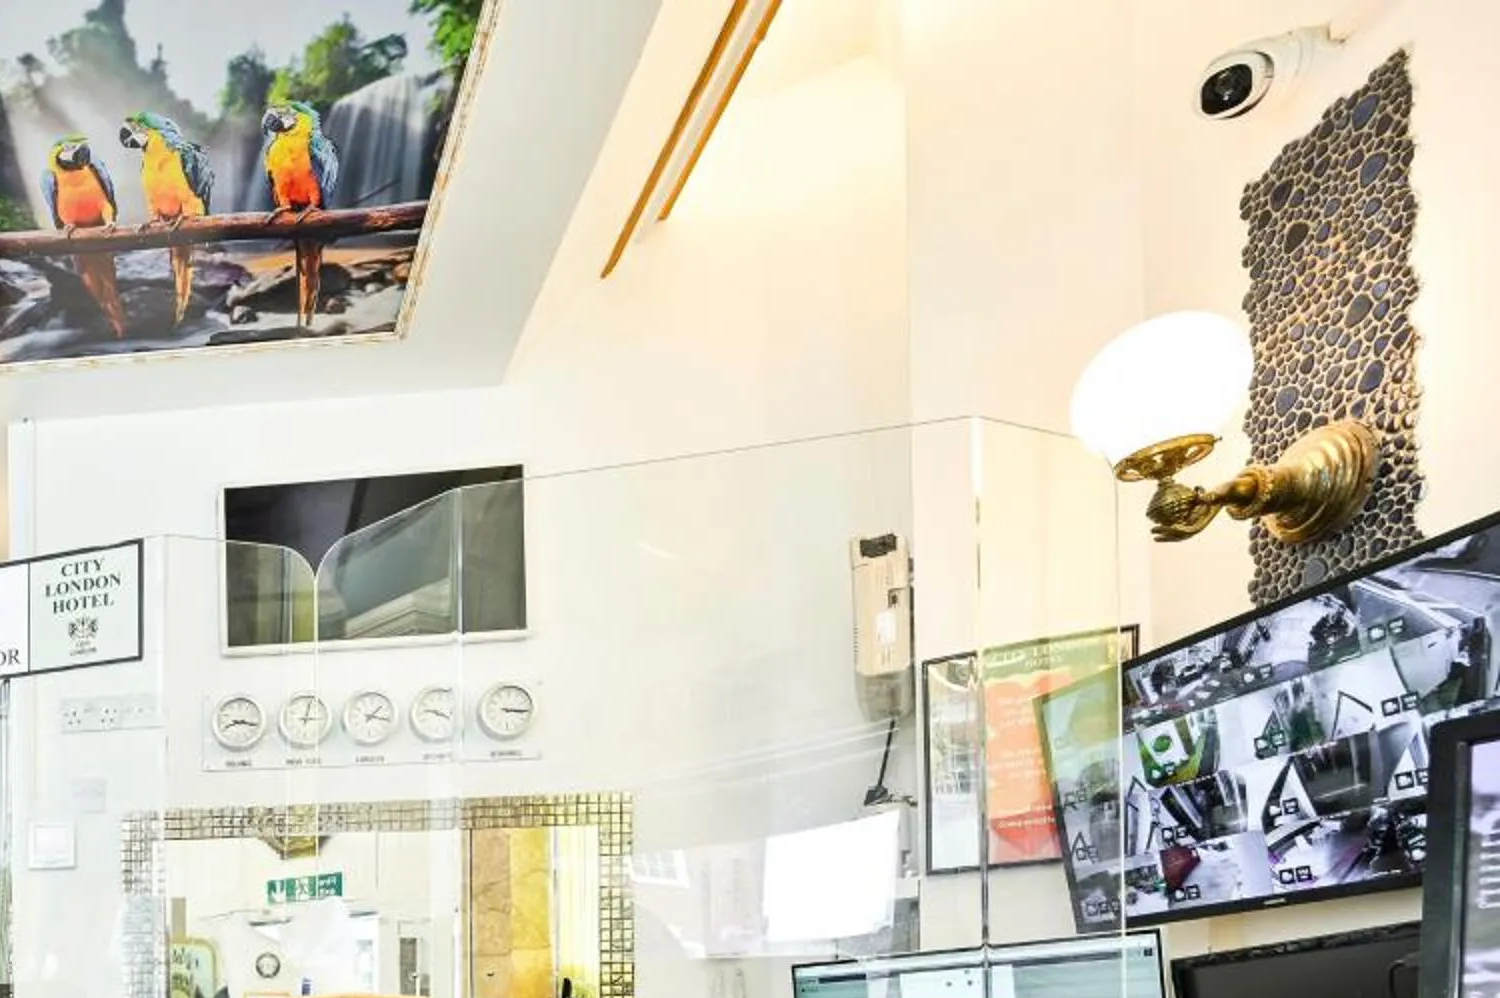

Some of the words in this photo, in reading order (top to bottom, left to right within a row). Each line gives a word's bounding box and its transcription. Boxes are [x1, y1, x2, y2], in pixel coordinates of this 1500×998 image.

[61, 557, 106, 576] CITY
[45, 571, 121, 597] LONDON
[53, 592, 115, 614] HOTEL
